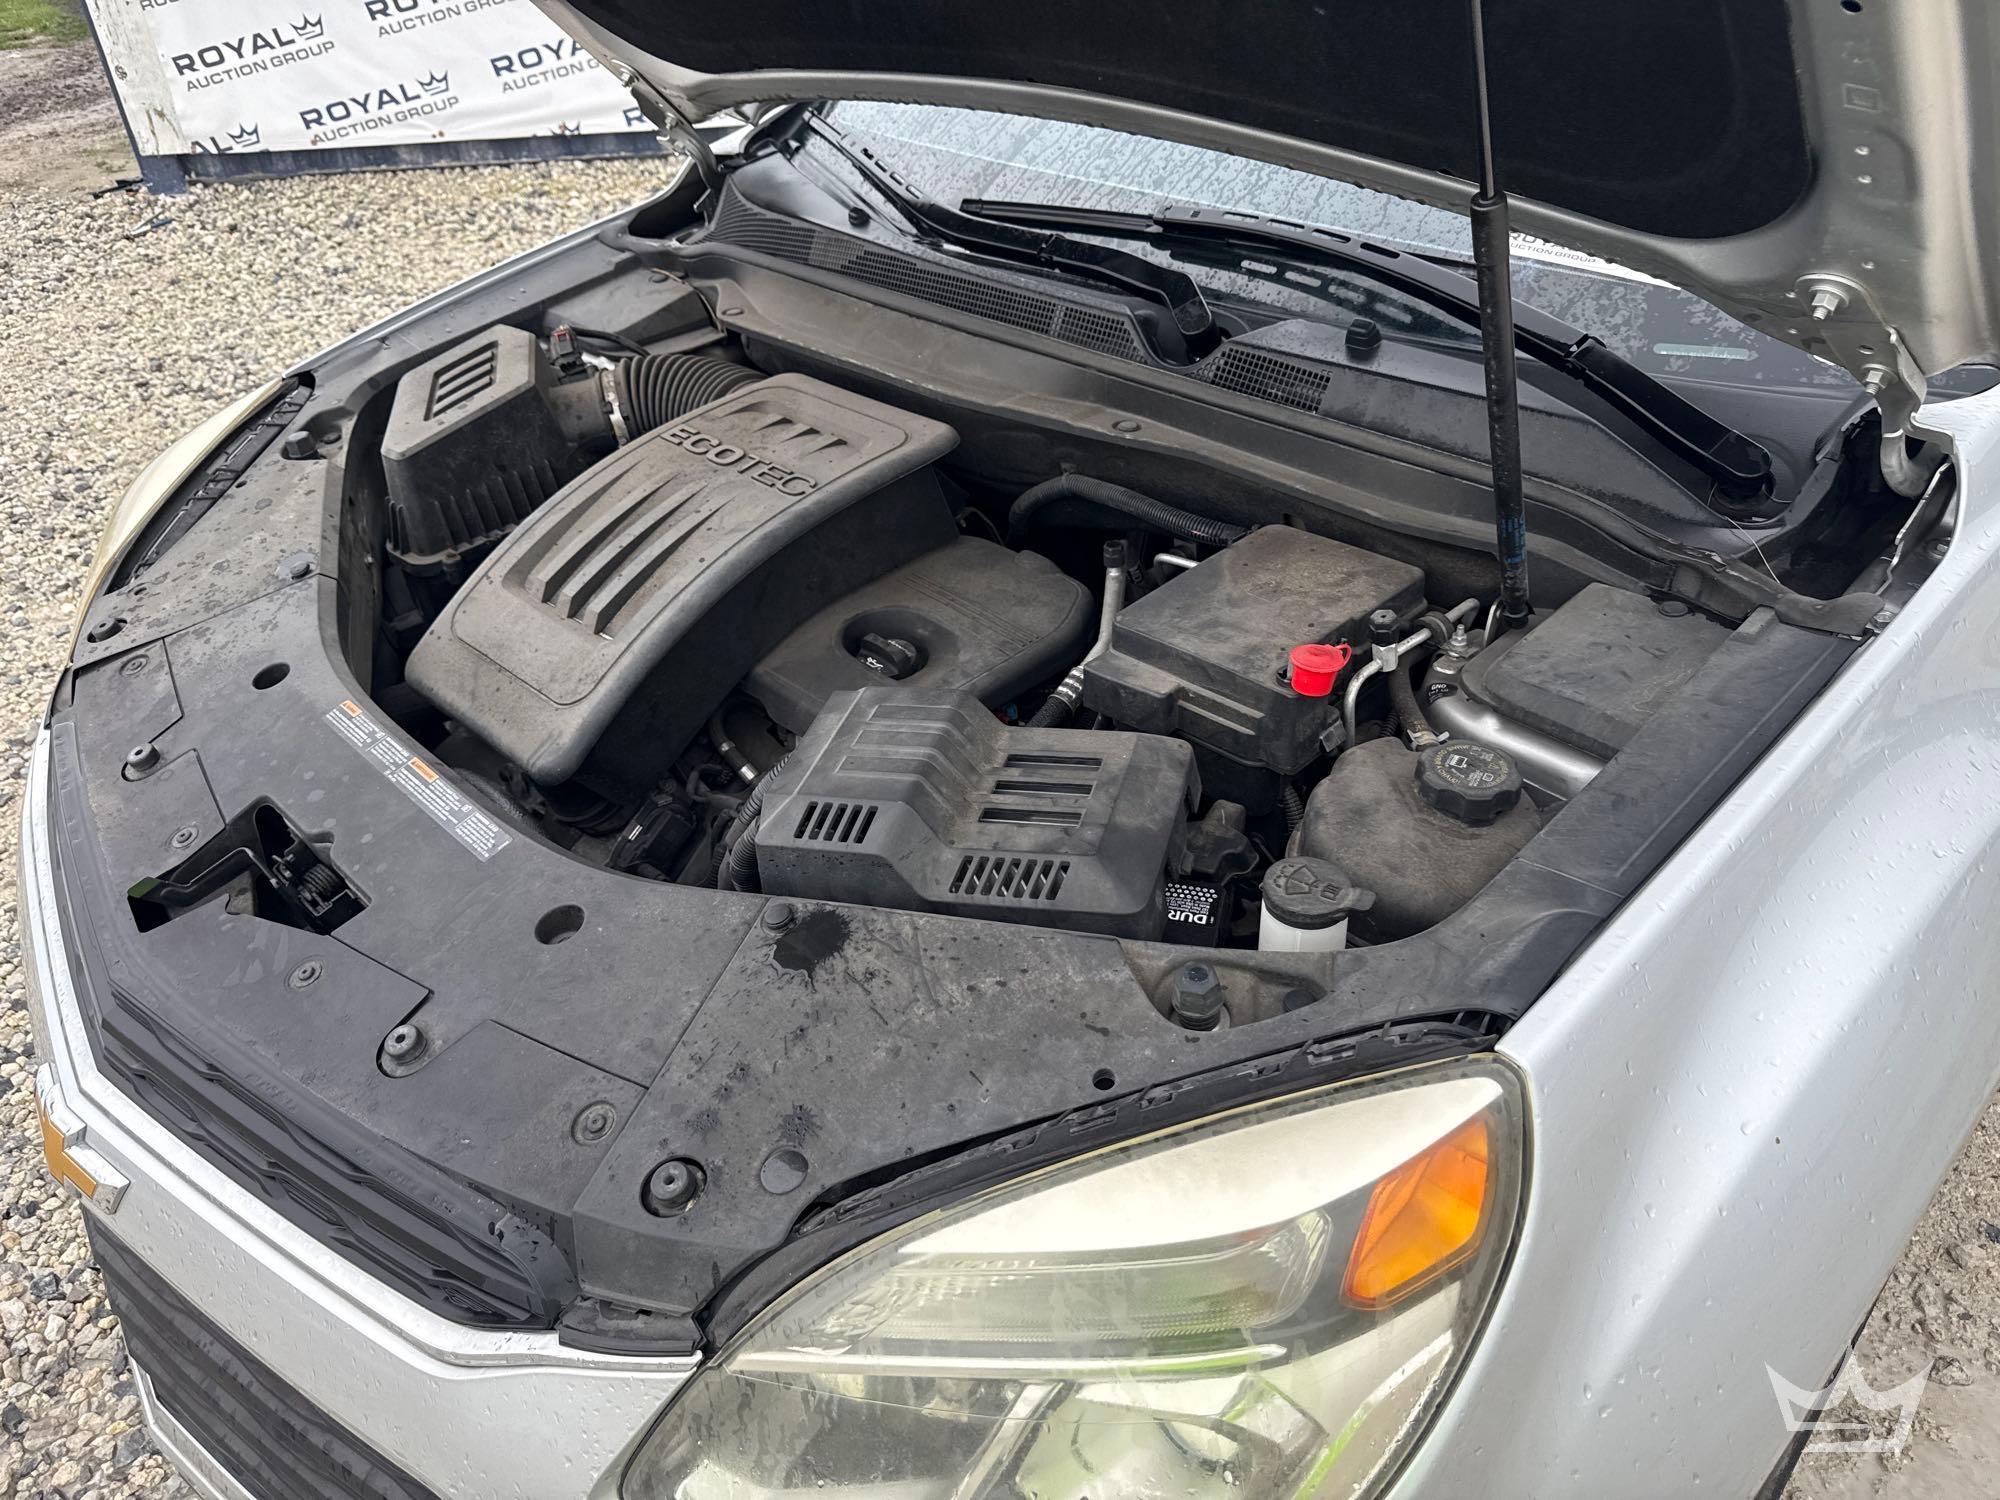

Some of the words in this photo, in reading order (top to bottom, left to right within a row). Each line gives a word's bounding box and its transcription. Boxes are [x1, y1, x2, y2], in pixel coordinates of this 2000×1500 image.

[378, 4, 462, 38] AUCTION
[171, 27, 296, 76] ROYAL
[187, 58, 269, 92] AUCTION
[270, 40, 335, 68] GROUP
[490, 39, 585, 77] ROYA
[502, 62, 584, 93] AUCTION
[299, 83, 421, 130] ROYAL
[312, 113, 392, 144] AUCTION
[394, 95, 459, 122] GROUP
[1510, 242, 1553, 255] UCTION
[659, 425, 817, 497] ECOTEC
